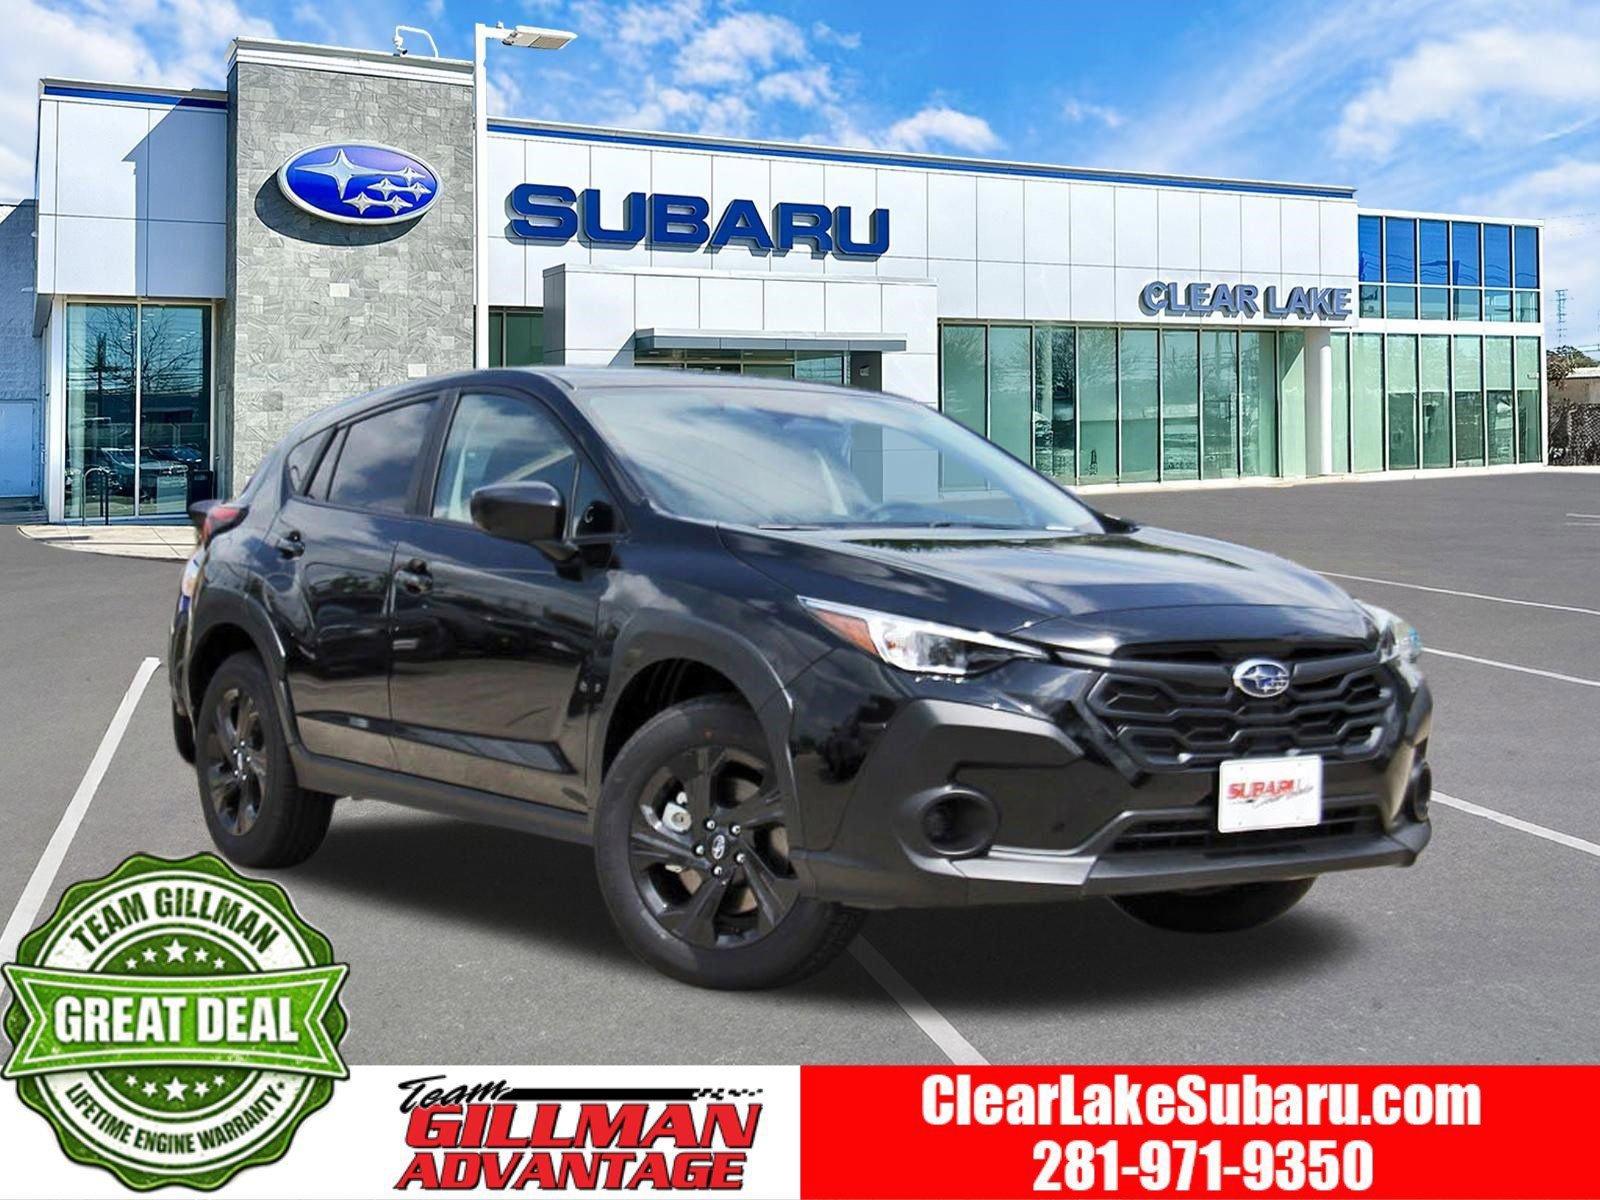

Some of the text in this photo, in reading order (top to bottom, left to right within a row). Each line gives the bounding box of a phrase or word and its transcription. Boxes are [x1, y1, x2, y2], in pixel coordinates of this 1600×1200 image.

[505, 183, 890, 261] SUBARU
[1139, 281, 1352, 321] CLEAR LAKE
